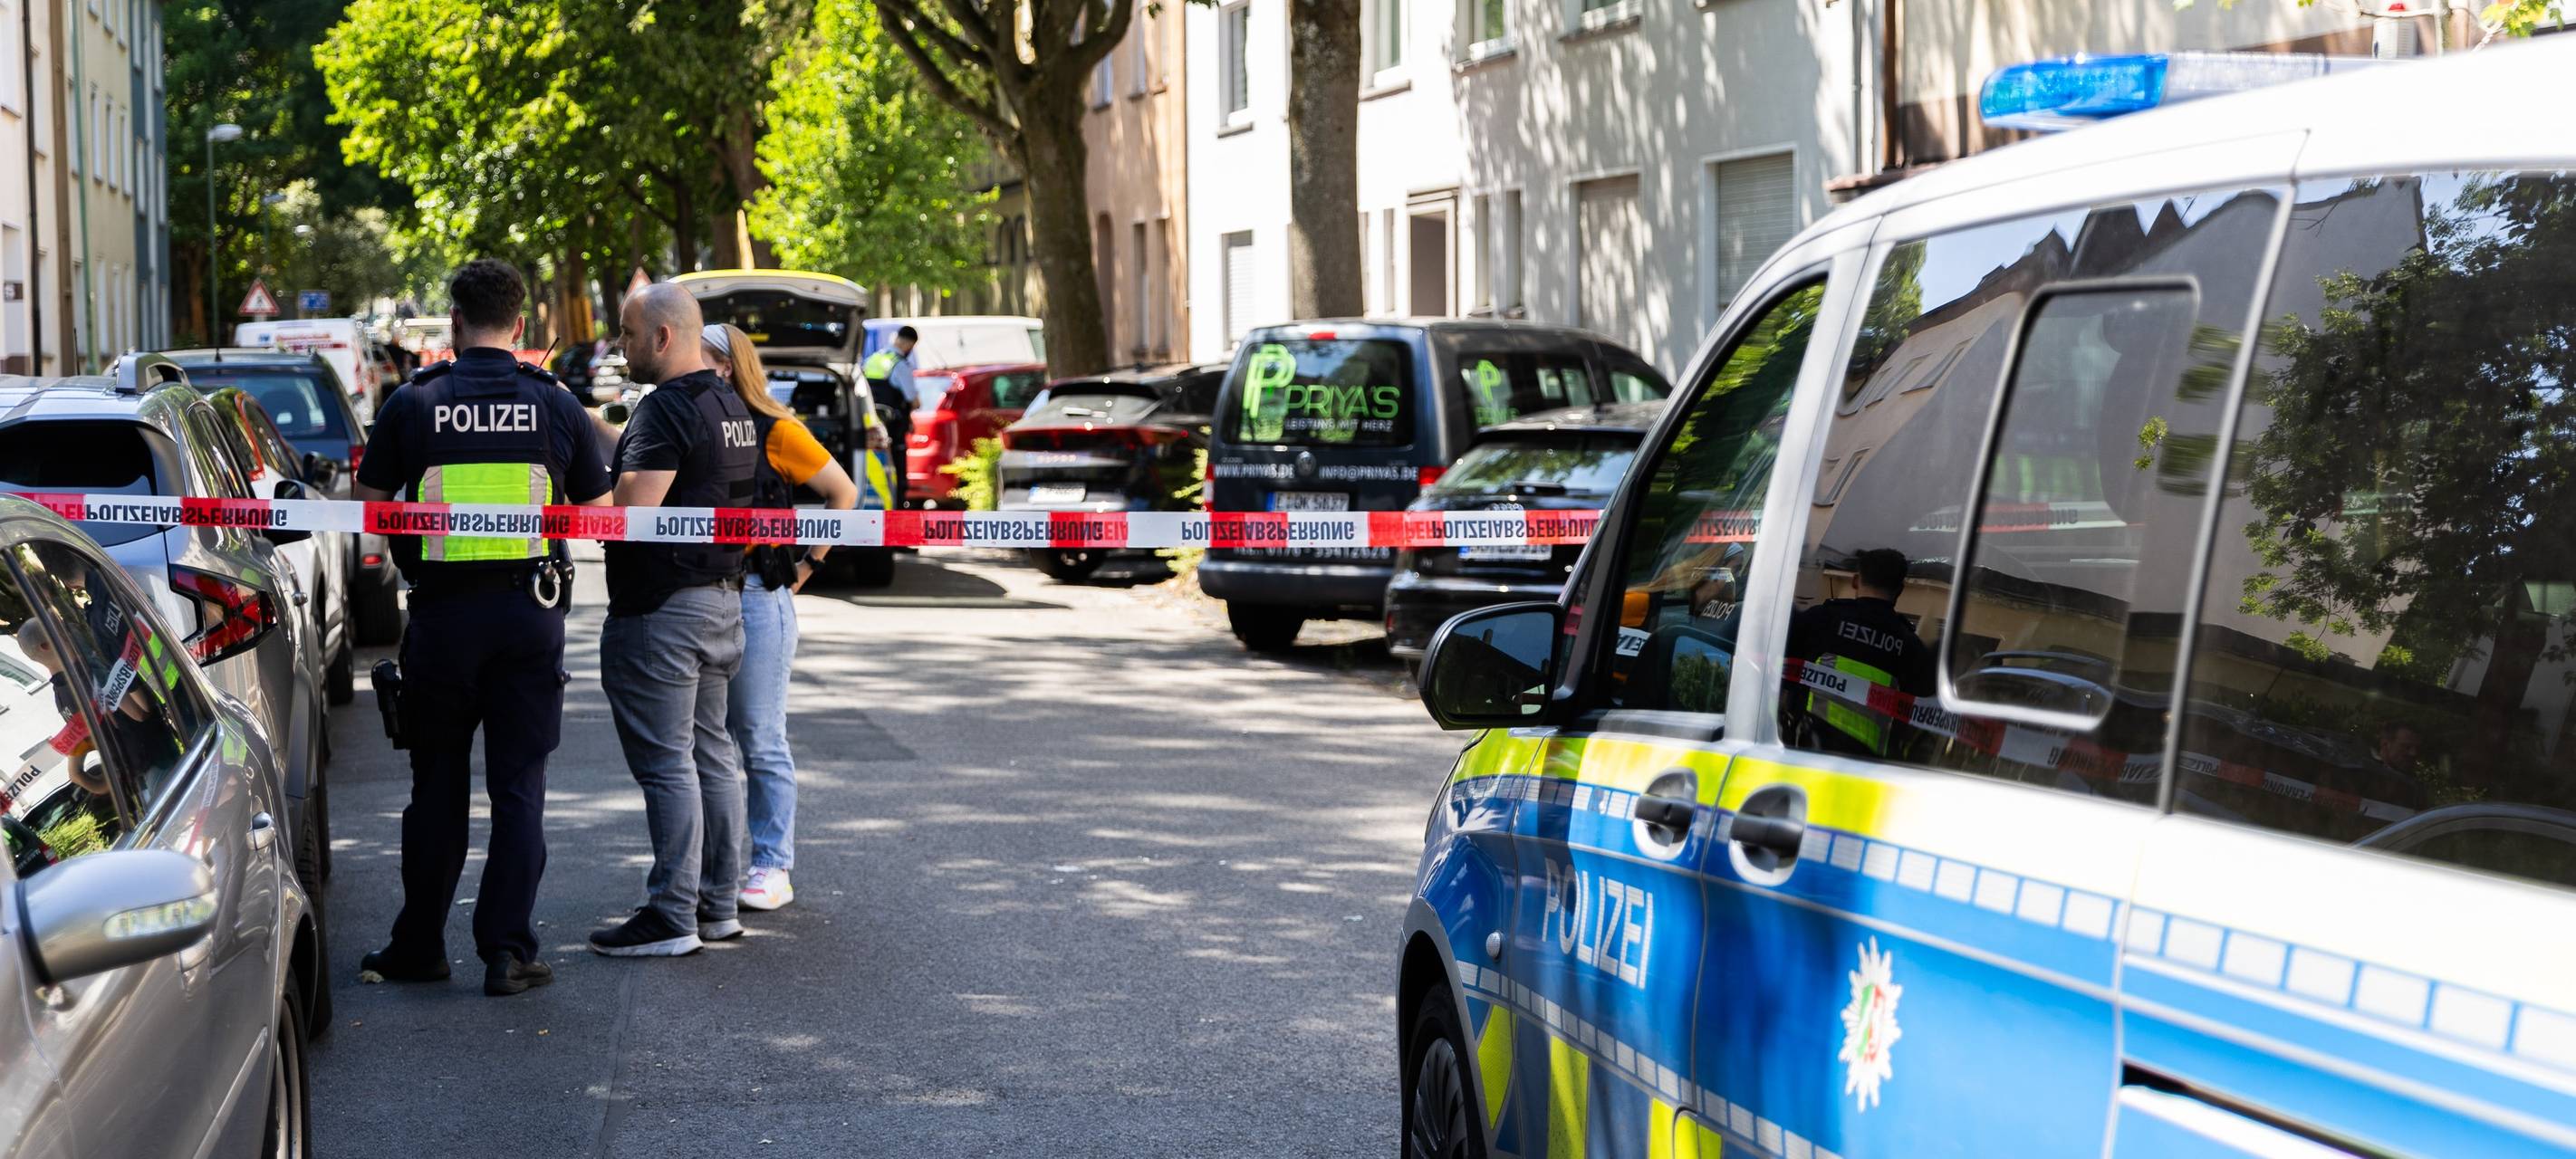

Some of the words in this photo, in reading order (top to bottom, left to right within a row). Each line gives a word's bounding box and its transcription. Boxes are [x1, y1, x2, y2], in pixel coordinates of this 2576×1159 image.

[435, 404, 537, 433] POLIZEI
[721, 419, 757, 448] POLIZE
[1542, 857, 1655, 991] POLIZEI
